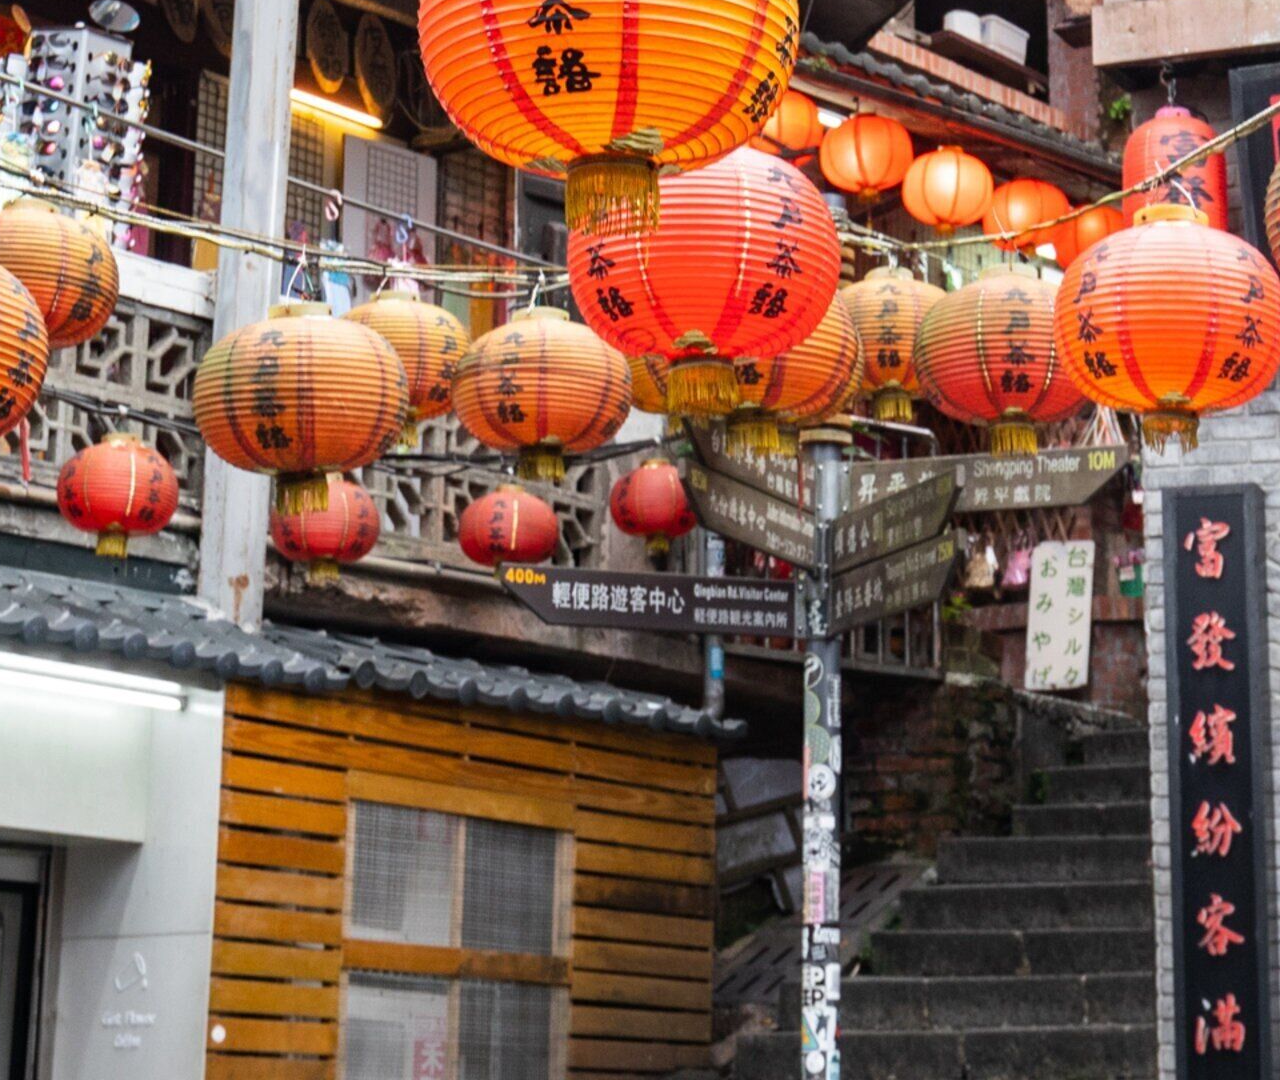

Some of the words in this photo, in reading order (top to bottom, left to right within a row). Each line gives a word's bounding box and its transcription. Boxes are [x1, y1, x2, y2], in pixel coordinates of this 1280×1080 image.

[973, 457, 1034, 480] Shengping
[1037, 455, 1081, 472] Theater
[1087, 451, 1116, 471] 10M
[505, 568, 547, 585] 400M
[551, 579, 686, 615] 輕便路遊客中心
[1183, 517, 1248, 1055] 富發繽紛客滿
